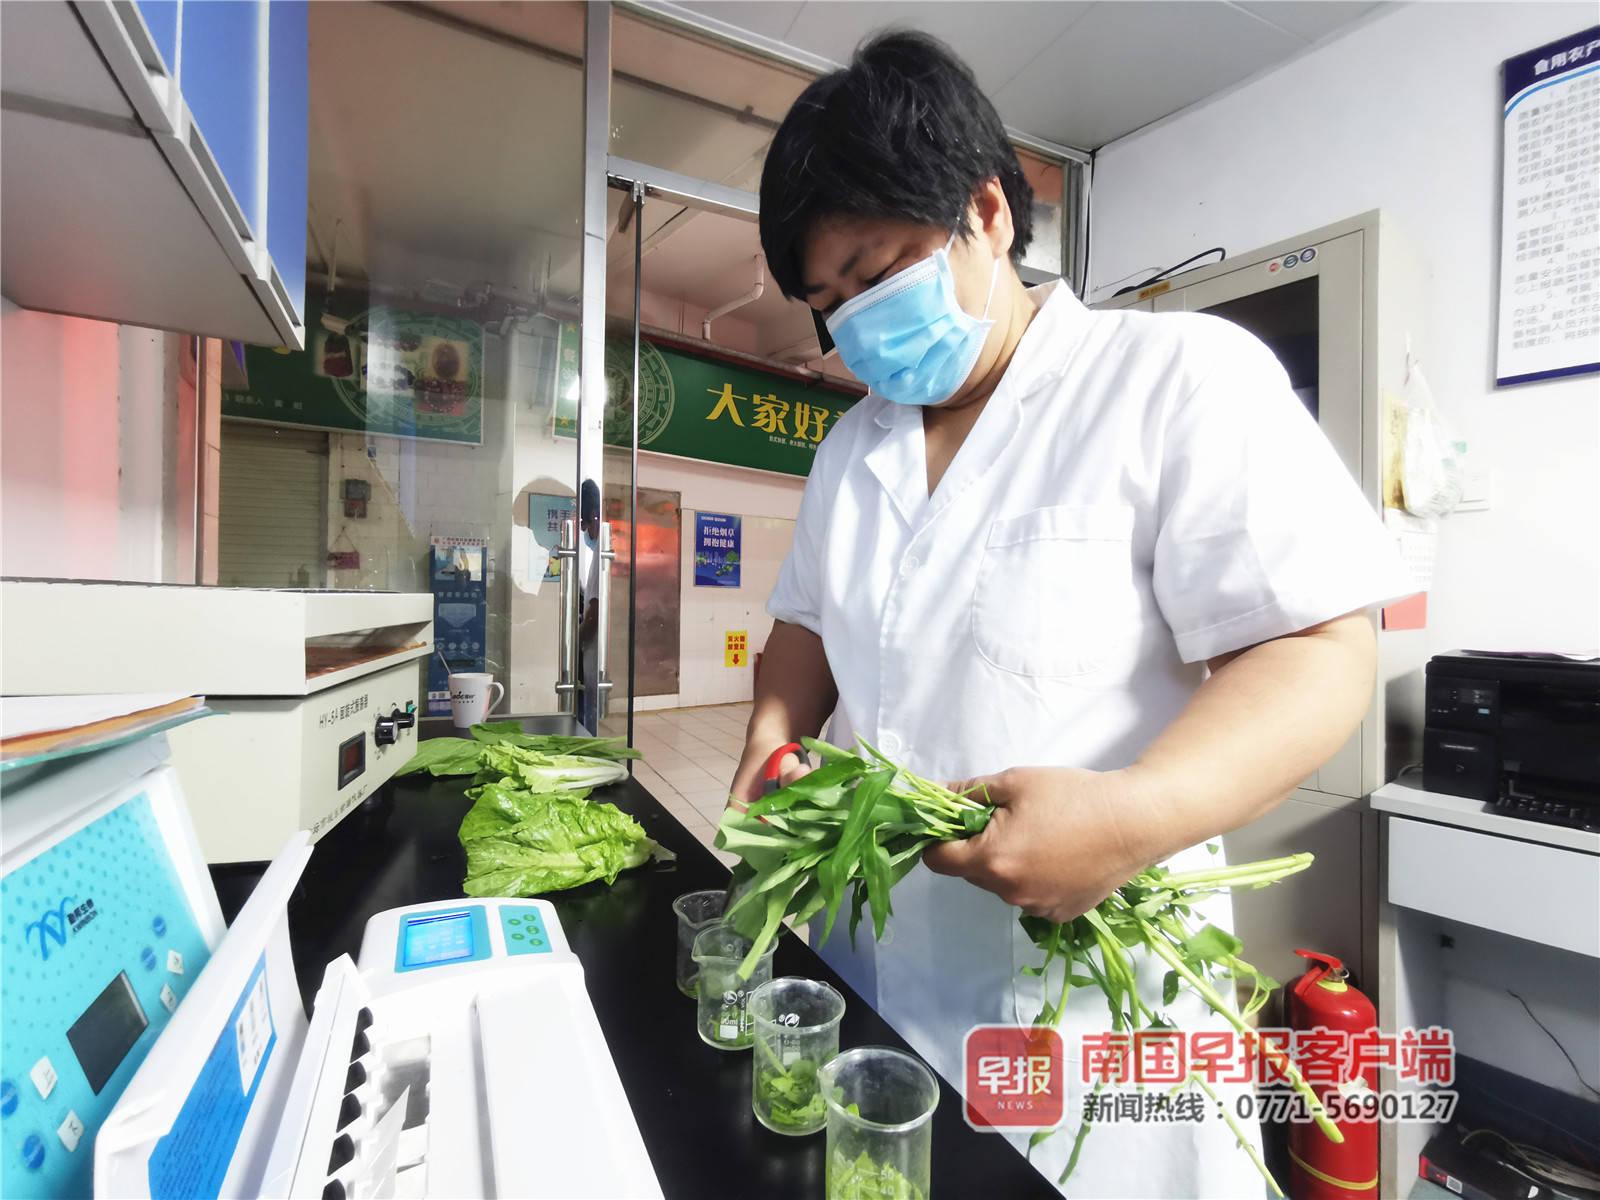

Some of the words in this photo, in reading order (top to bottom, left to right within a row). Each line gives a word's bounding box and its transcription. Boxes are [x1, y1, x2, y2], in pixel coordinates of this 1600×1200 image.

[705, 383, 846, 442] 大家好
[703, 526, 735, 537] 拒绝烟草
[703, 537, 735, 548] 拥抱健康
